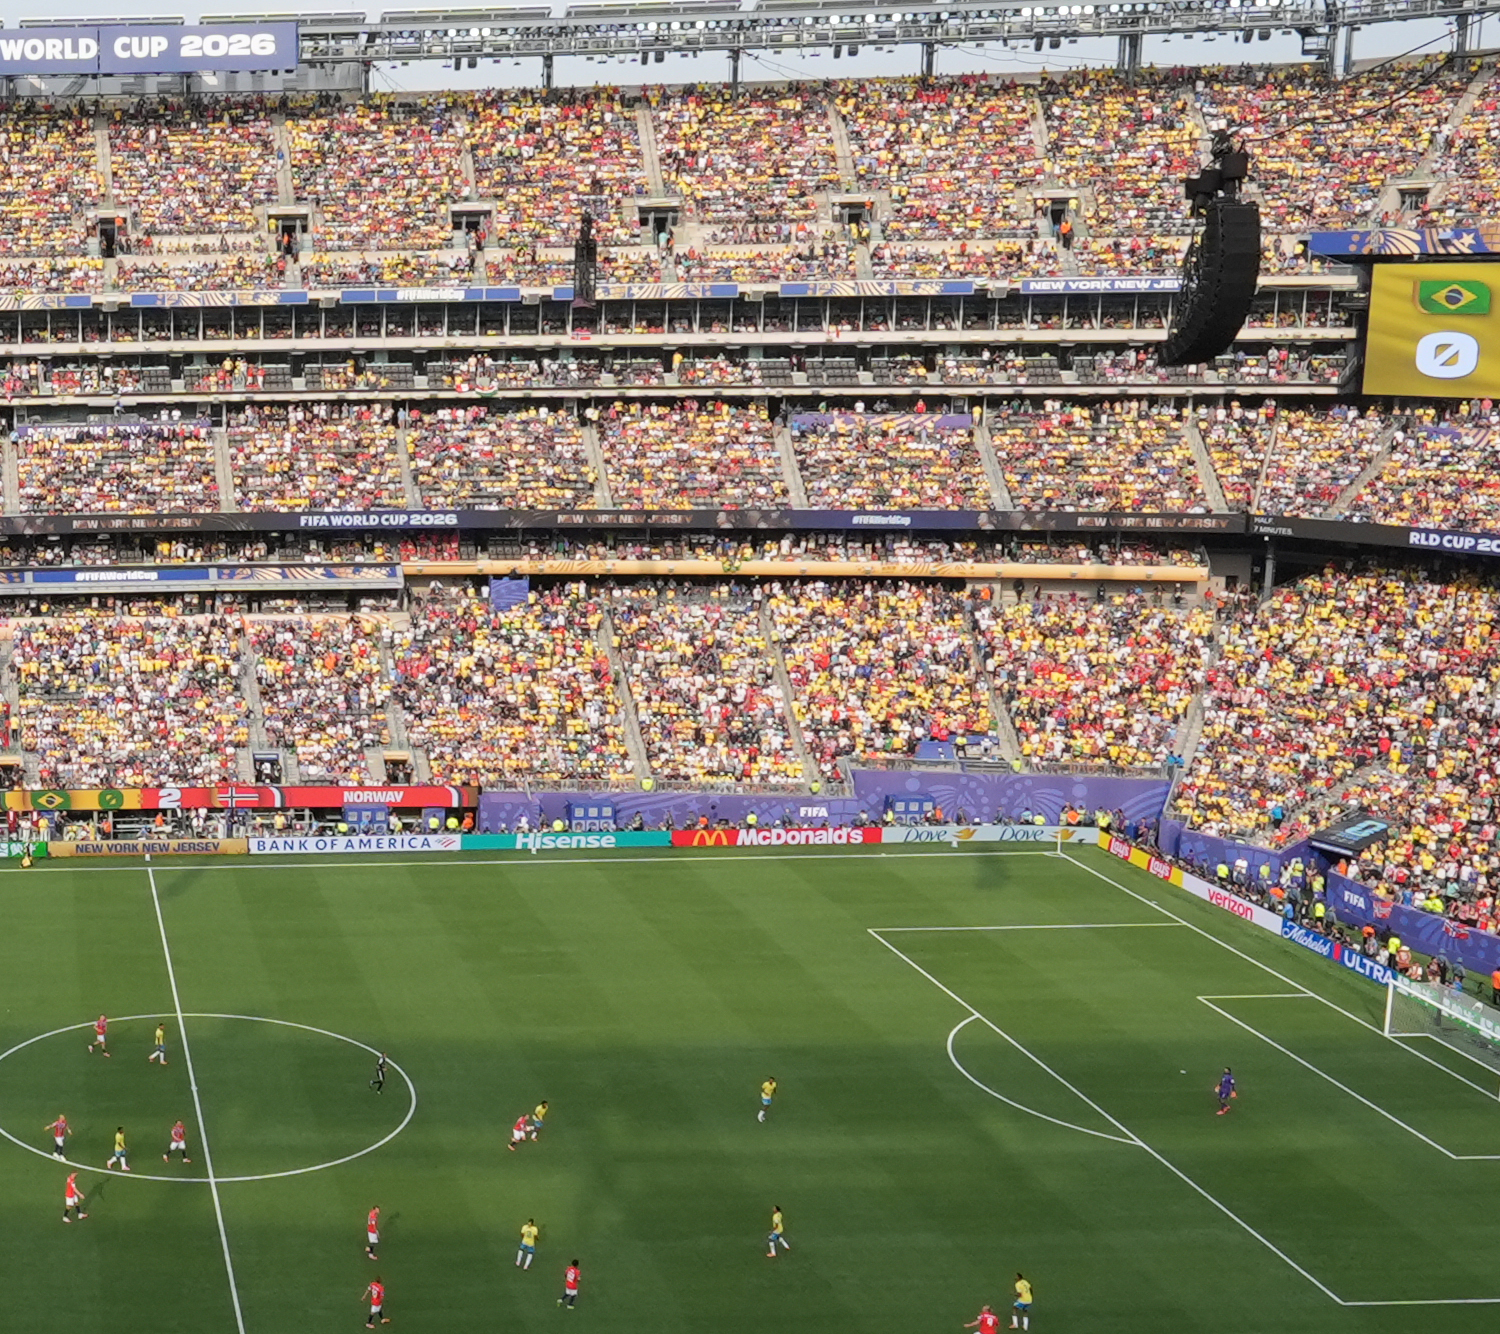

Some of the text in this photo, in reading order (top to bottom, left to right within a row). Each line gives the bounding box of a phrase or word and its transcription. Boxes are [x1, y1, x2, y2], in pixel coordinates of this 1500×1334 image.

[113, 36, 168, 58] CUP
[180, 33, 276, 58] 2026
[1029, 281, 1065, 290] NEW
[1068, 280, 1112, 289] YORK
[1114, 280, 1151, 289] NEW
[1415, 330, 1480, 379] 0
[300, 513, 458, 527] FIFA WORLD CUP 2026
[1077, 516, 1229, 528] NEW YORK NEW JERSEY
[1408, 531, 1440, 546] RLD
[1442, 535, 1475, 549] CUP
[158, 788, 182, 809] 2
[343, 790, 404, 803] NORWAY
[800, 806, 829, 817] FIFA
[515, 832, 617, 849] Hisense
[736, 827, 864, 846] McDonald's
[903, 825, 947, 843] Dove
[999, 825, 1044, 843] Dove
[75, 841, 220, 854] NEW YORK NEW JERSEY
[257, 836, 431, 851] BANK OF AMERICA
[1207, 888, 1254, 921] verizon
[1344, 889, 1365, 909] FIFA
[1281, 920, 1392, 986] Michelob ULTRA
